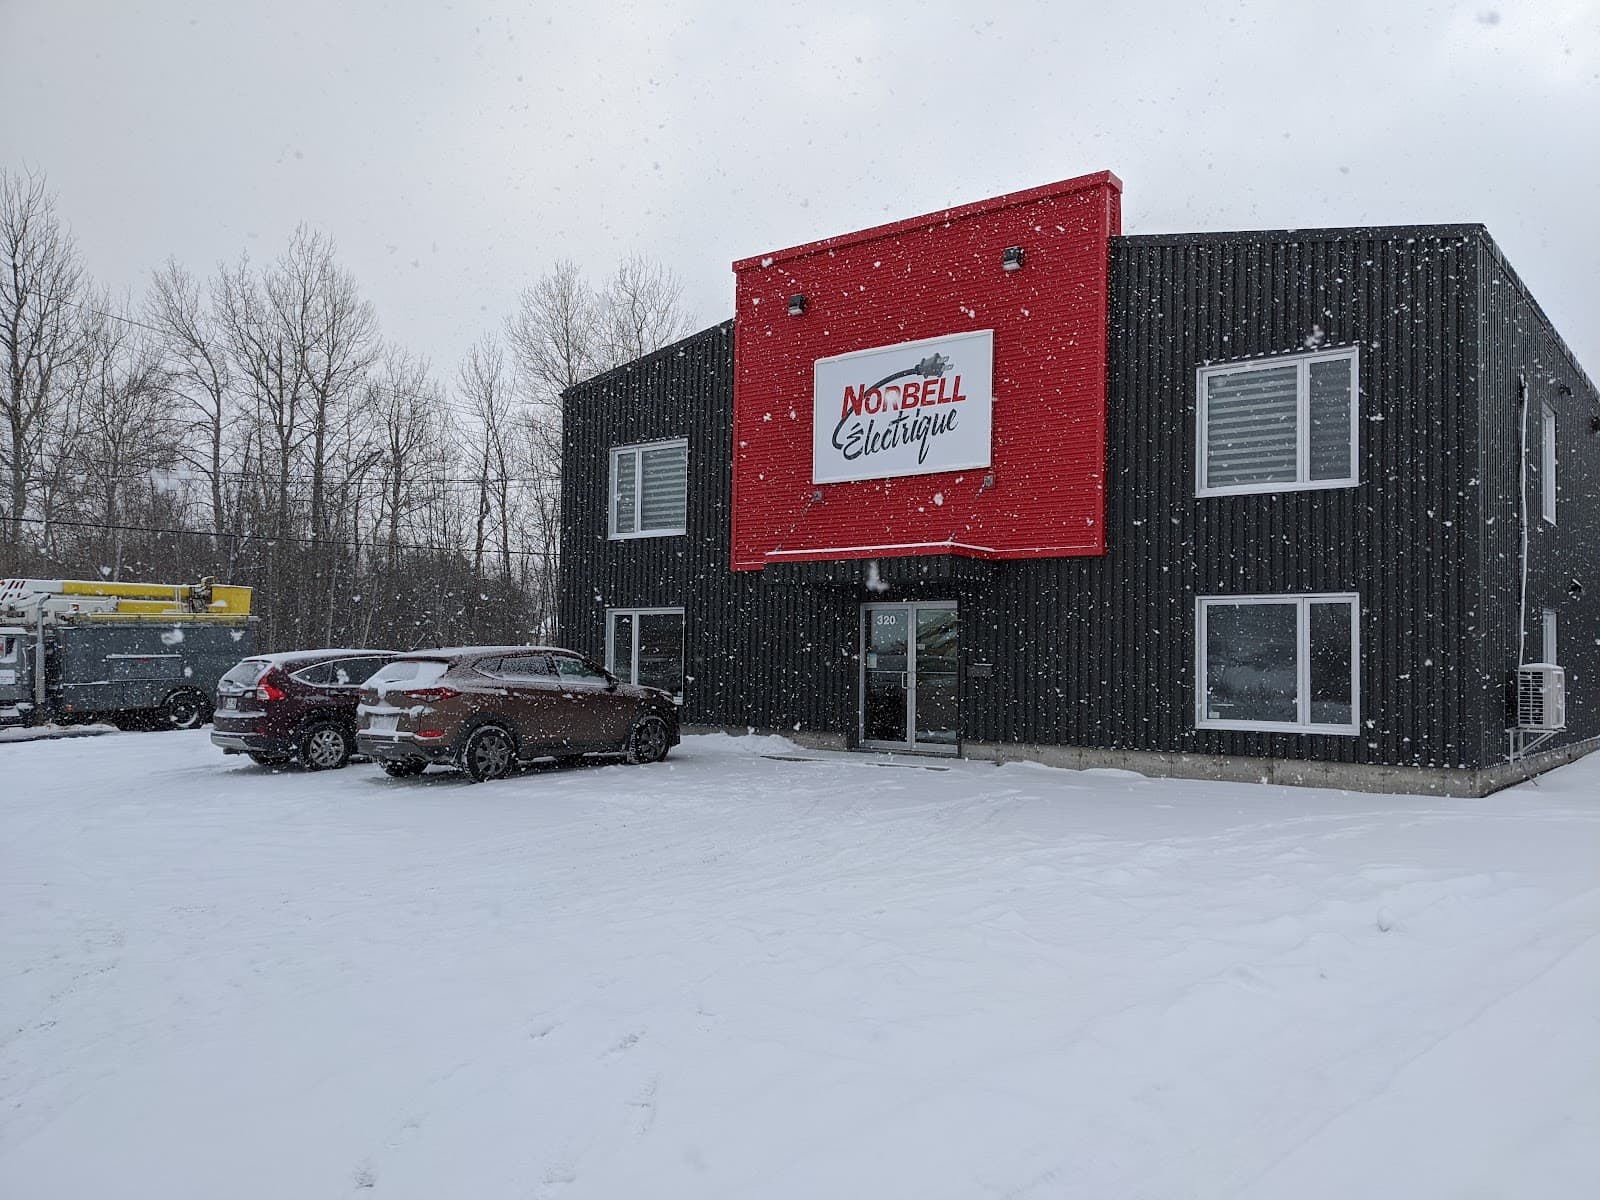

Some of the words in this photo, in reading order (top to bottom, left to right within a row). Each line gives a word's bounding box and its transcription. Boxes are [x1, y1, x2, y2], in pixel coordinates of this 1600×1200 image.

[841, 375, 967, 419] NORBELL
[843, 408, 959, 465] Électrique
[876, 615, 896, 625] 320
